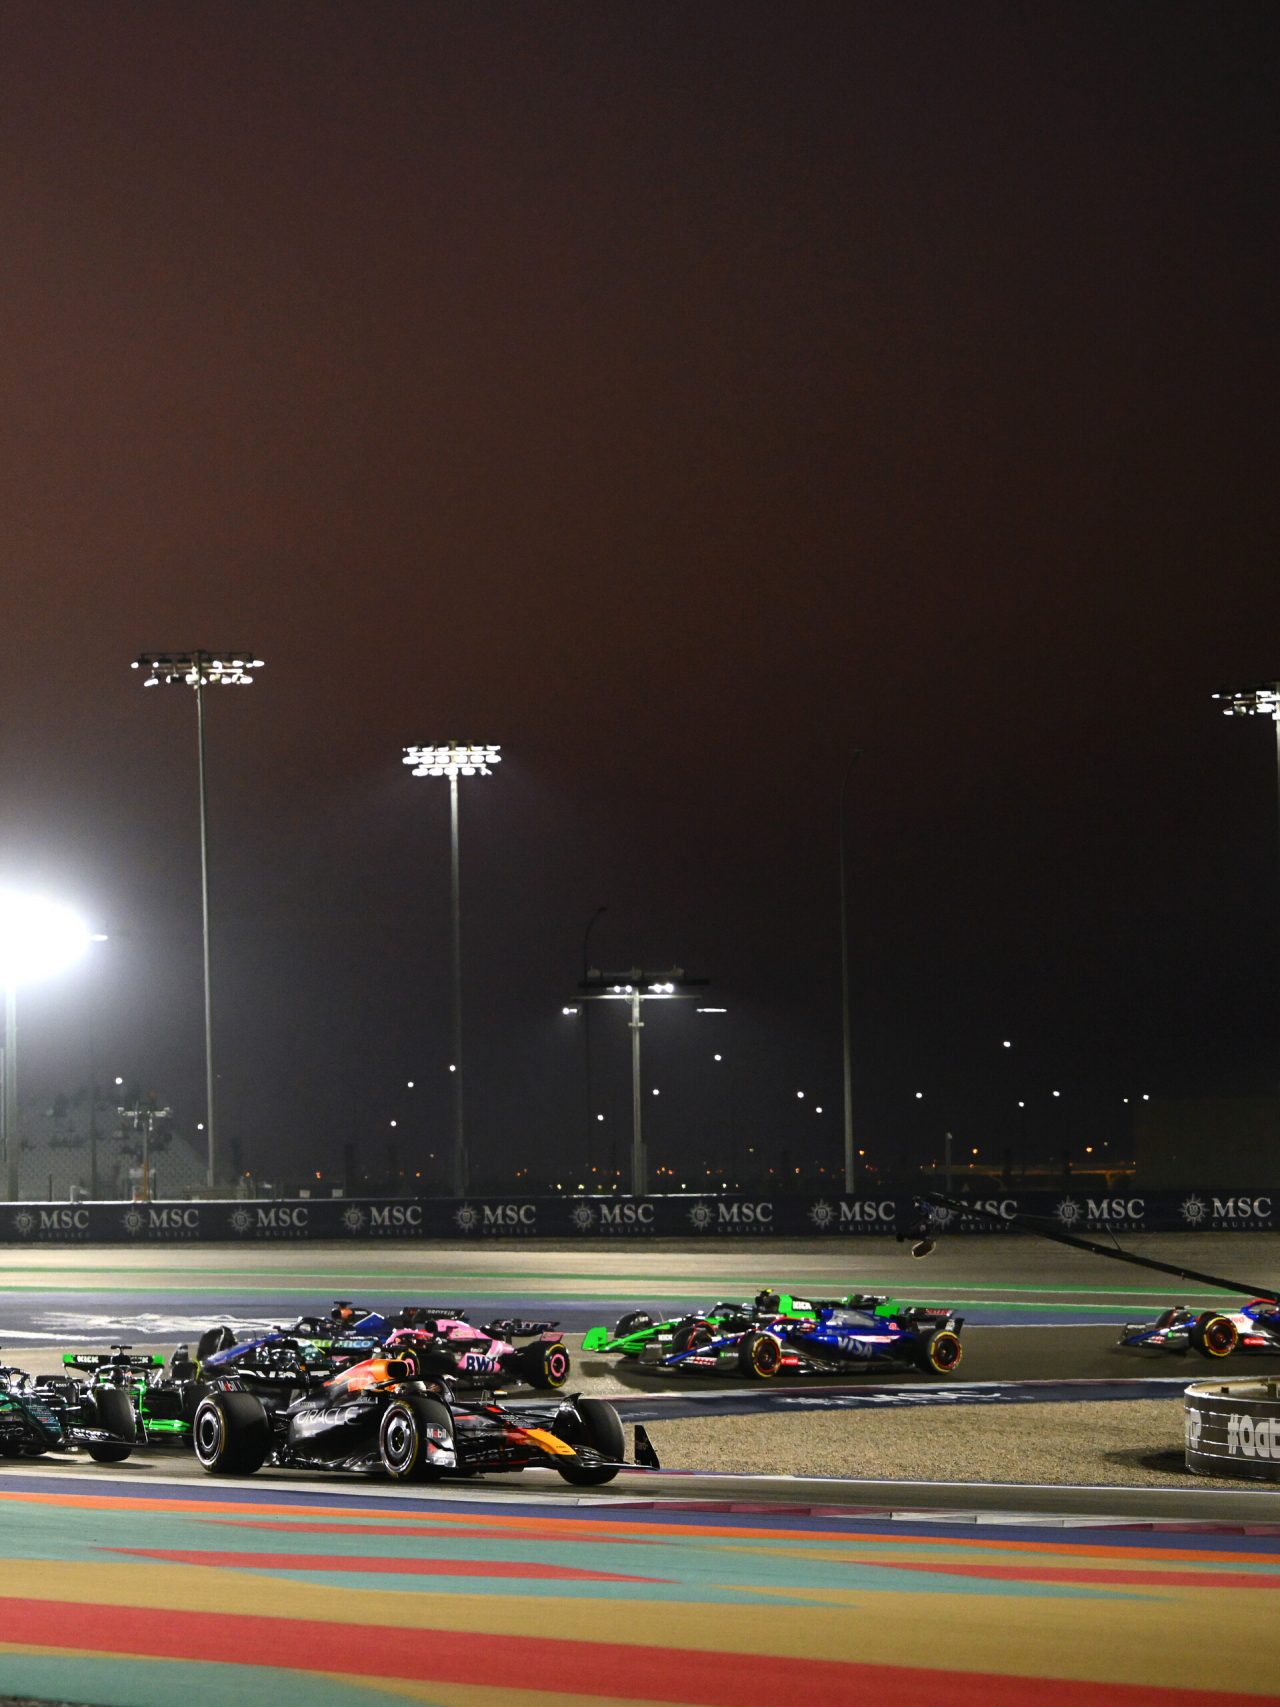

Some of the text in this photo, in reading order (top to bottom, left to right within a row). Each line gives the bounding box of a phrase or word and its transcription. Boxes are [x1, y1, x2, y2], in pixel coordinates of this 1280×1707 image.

[256, 1207, 310, 1227] MSC
[369, 1206, 422, 1225] MSC
[482, 1204, 537, 1224] MSC
[599, 1203, 656, 1223] MSC
[717, 1203, 774, 1223] MSC
[838, 1201, 897, 1221] MSC
[1085, 1198, 1146, 1219] MSC
[1211, 1196, 1273, 1218] MSC
[39, 1209, 90, 1229] MSC
[148, 1208, 200, 1228] MSC
[837, 1336, 873, 1357] VISA
[466, 1356, 497, 1371] BWT
[296, 1407, 362, 1426] ORACLE
[426, 1428, 447, 1439] Mobil
